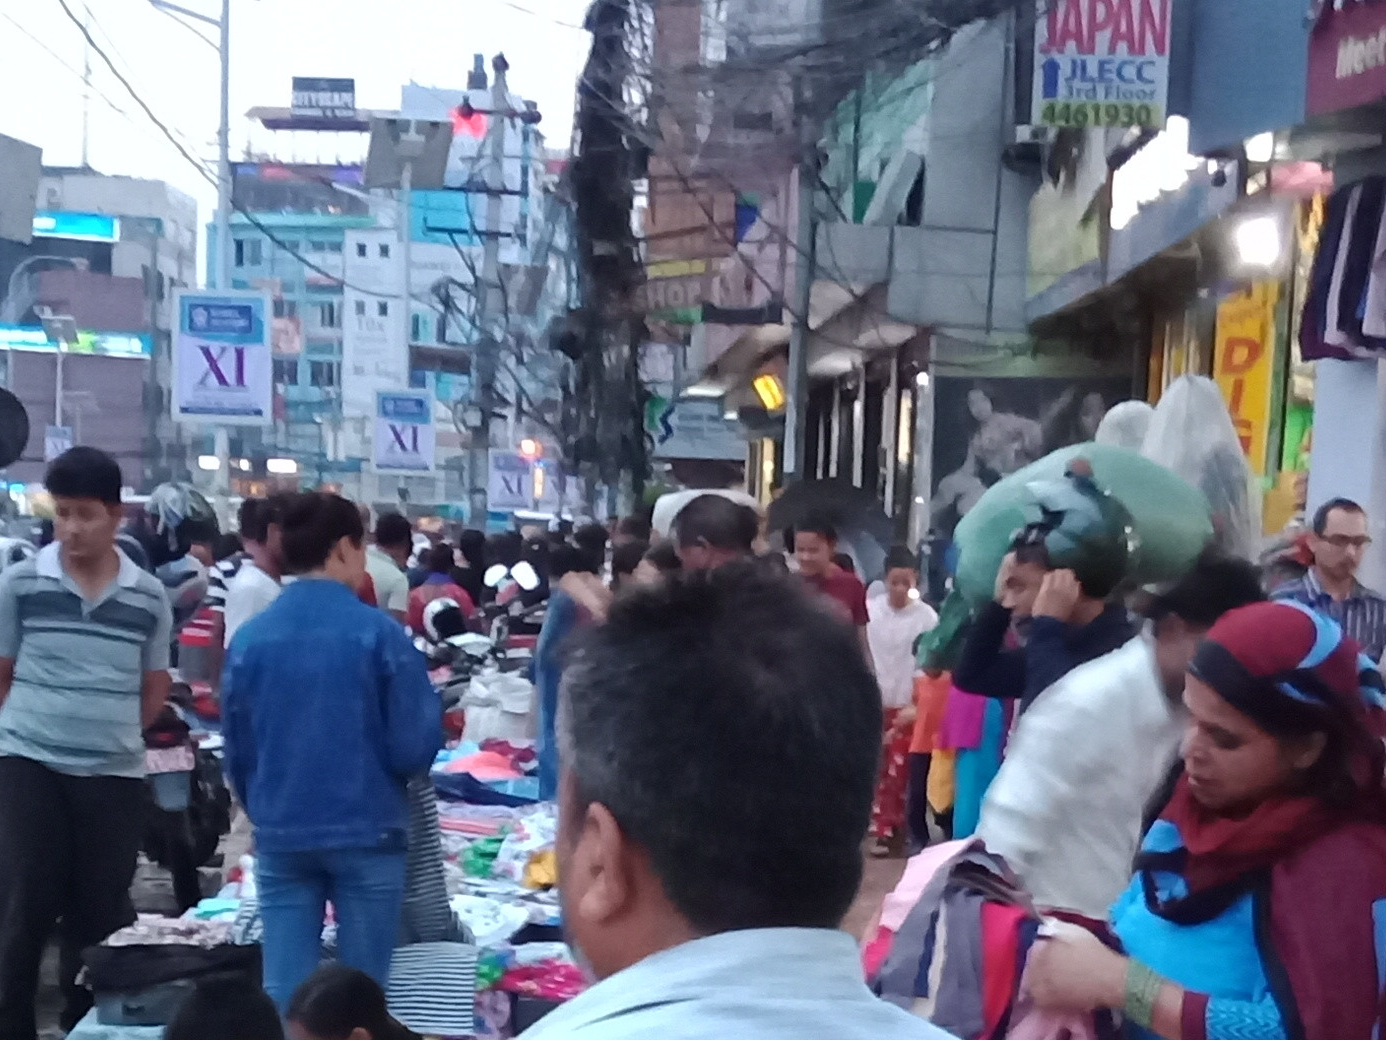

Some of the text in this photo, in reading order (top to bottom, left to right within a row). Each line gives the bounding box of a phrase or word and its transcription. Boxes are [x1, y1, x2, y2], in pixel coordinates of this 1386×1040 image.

[1040, 0, 1166, 55] JAPAN
[1336, 27, 1386, 79] Meet
[1065, 59, 1156, 83] JLECC
[1104, 83, 1156, 99] Floor
[1041, 102, 1151, 126] 4461930
[197, 345, 246, 387] XI
[384, 424, 419, 454] XI
